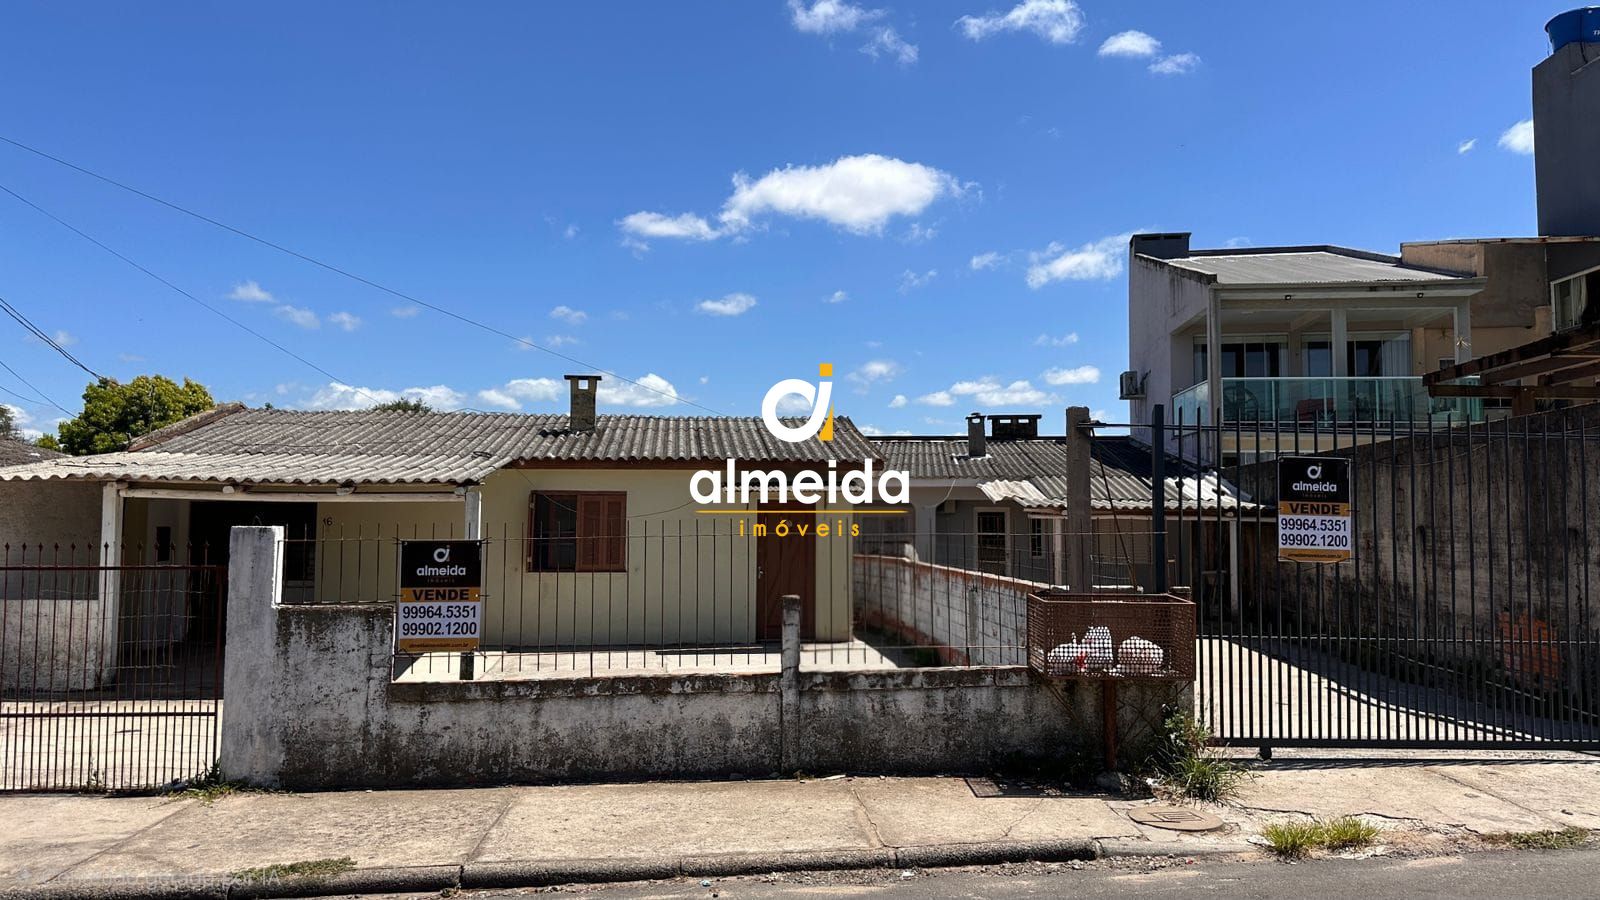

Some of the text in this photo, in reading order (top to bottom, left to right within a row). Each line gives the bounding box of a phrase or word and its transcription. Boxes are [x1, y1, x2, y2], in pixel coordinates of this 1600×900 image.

[1292, 481, 1337, 492] almeida
[1289, 503, 1340, 515] VENDE
[1281, 518, 1347, 532] 99964.5351
[1281, 534, 1348, 548] 99902.1200
[416, 565, 466, 576] almeida
[413, 589, 469, 600] VENDE
[402, 605, 476, 619] 99964.5351
[402, 622, 477, 636] 99902.1200
